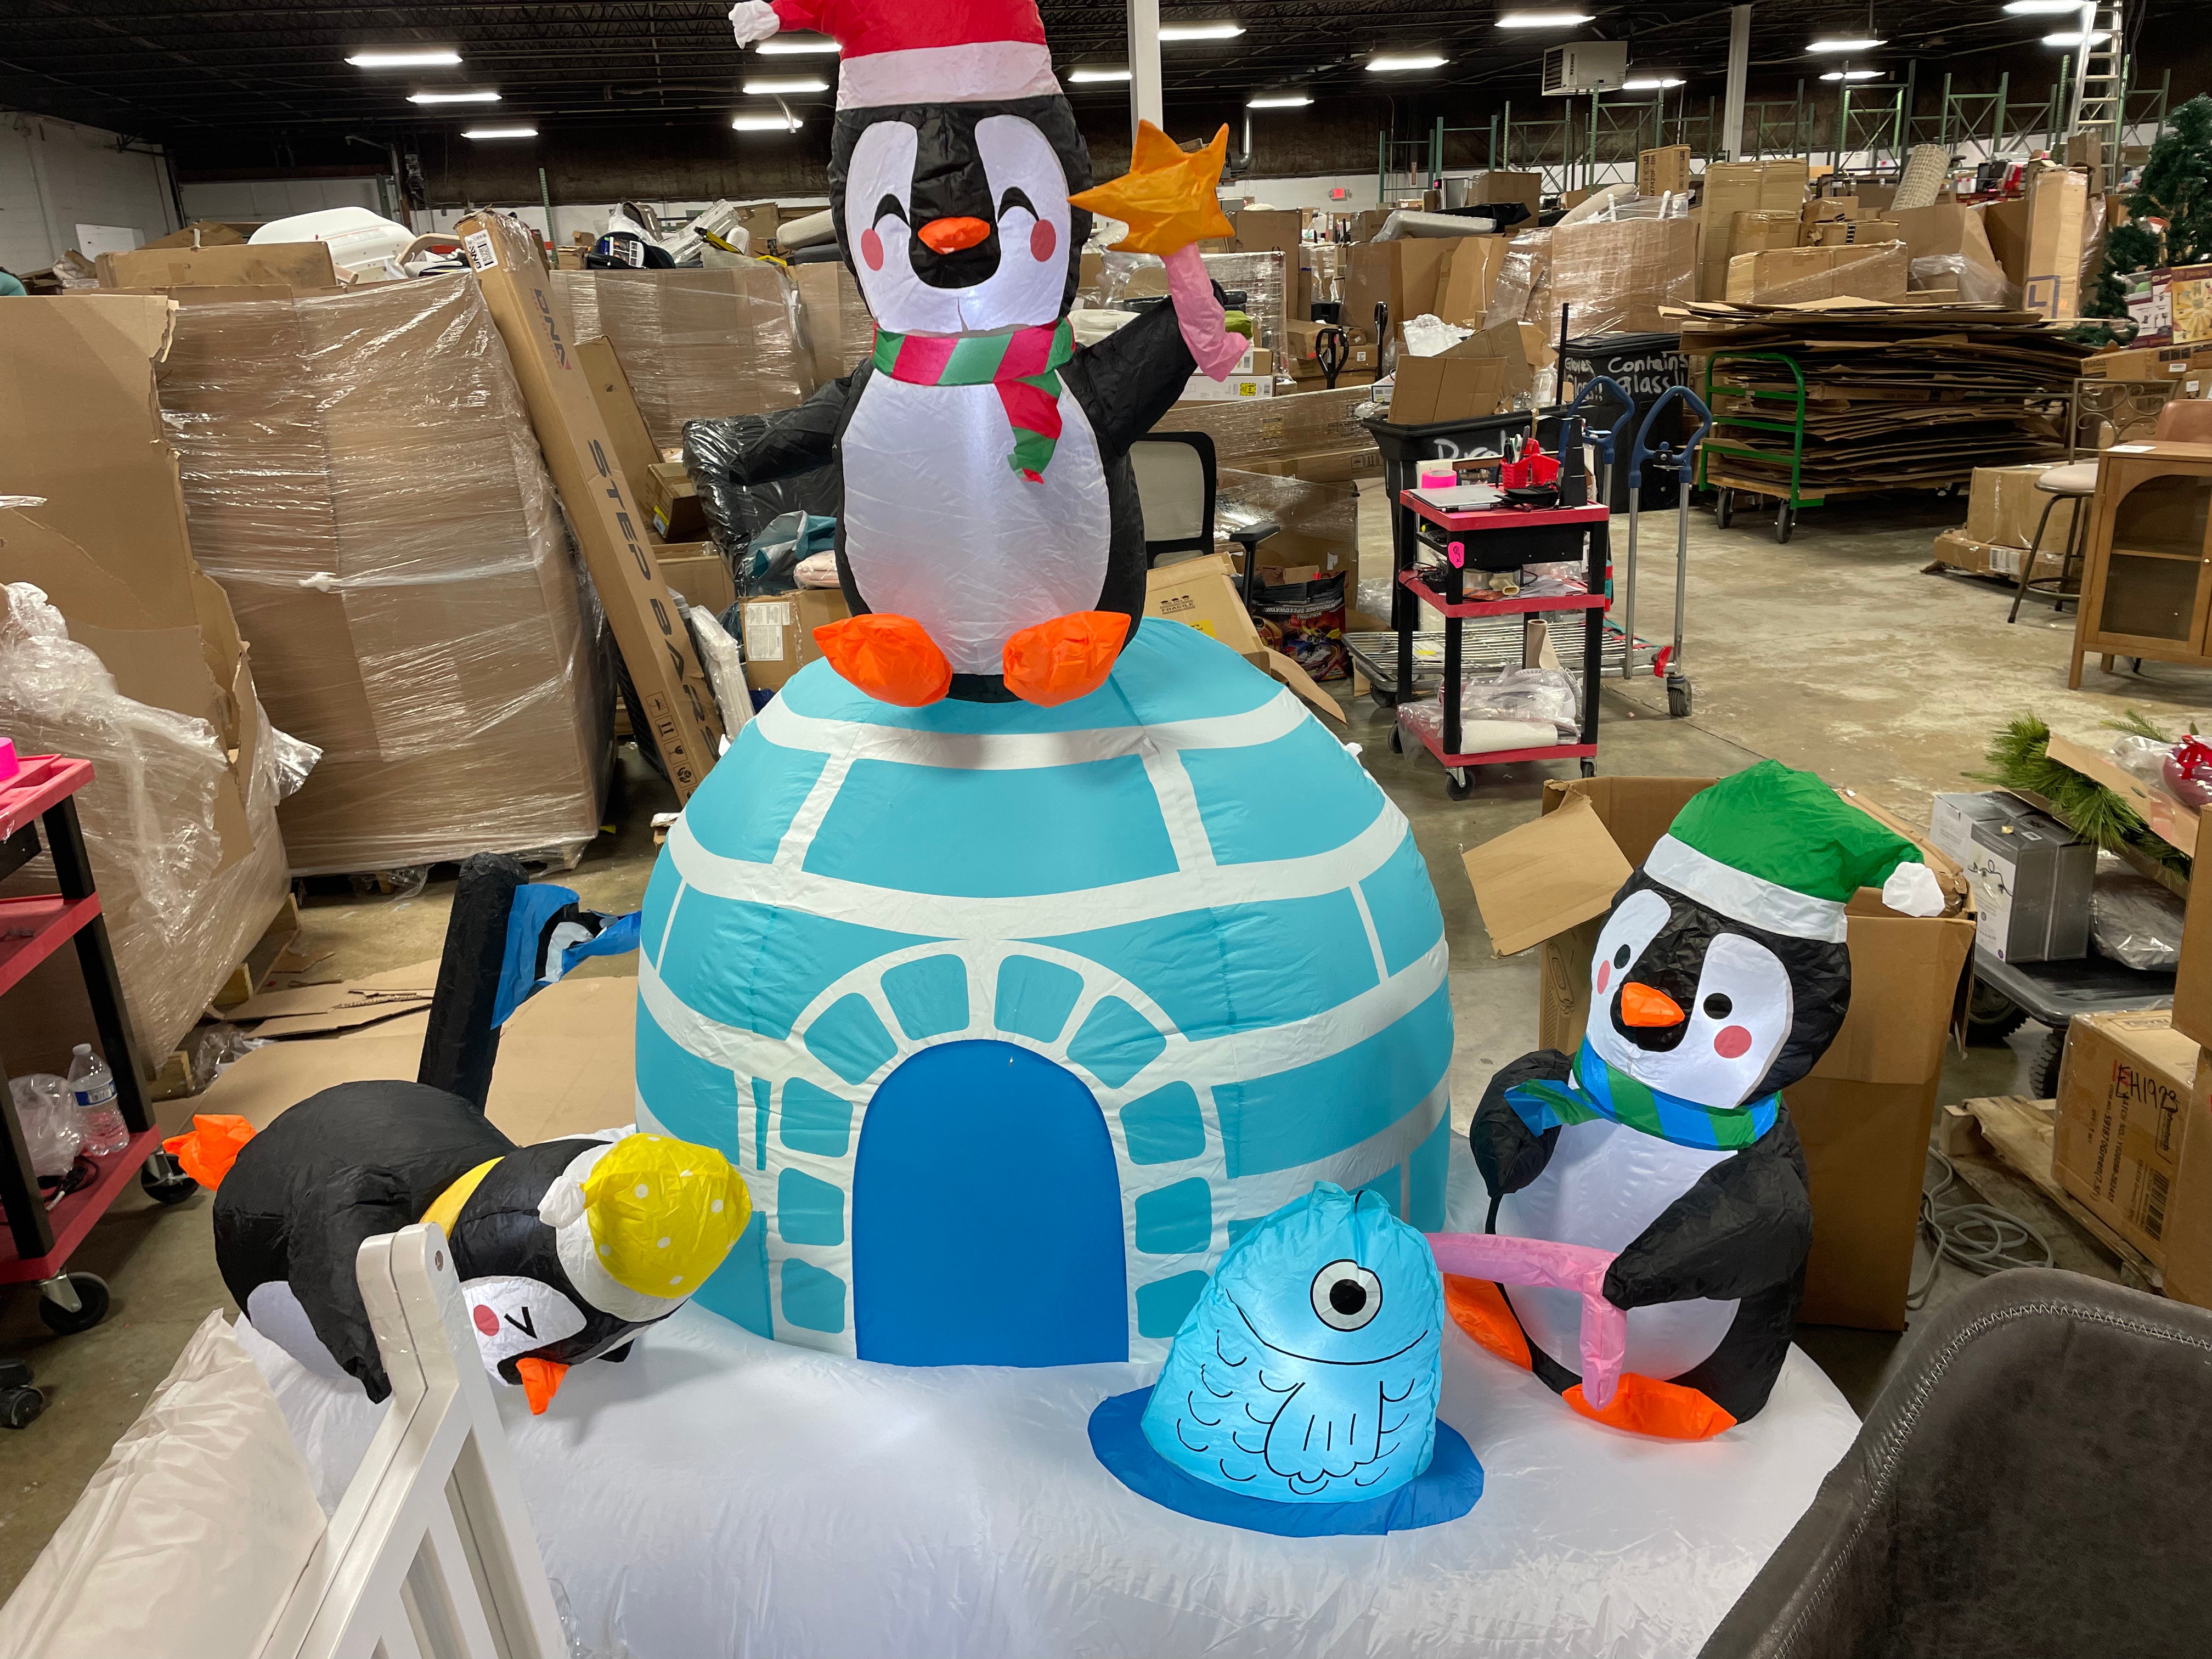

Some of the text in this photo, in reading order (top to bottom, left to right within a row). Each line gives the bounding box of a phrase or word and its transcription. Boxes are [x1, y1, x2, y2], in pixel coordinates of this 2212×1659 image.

[534, 288, 572, 370] DNA
[1565, 357, 1596, 379] Gloves
[1608, 352, 1689, 374] Contains
[588, 439, 721, 763] STEP BARS
[1161, 603, 1193, 612] FRAGILE
